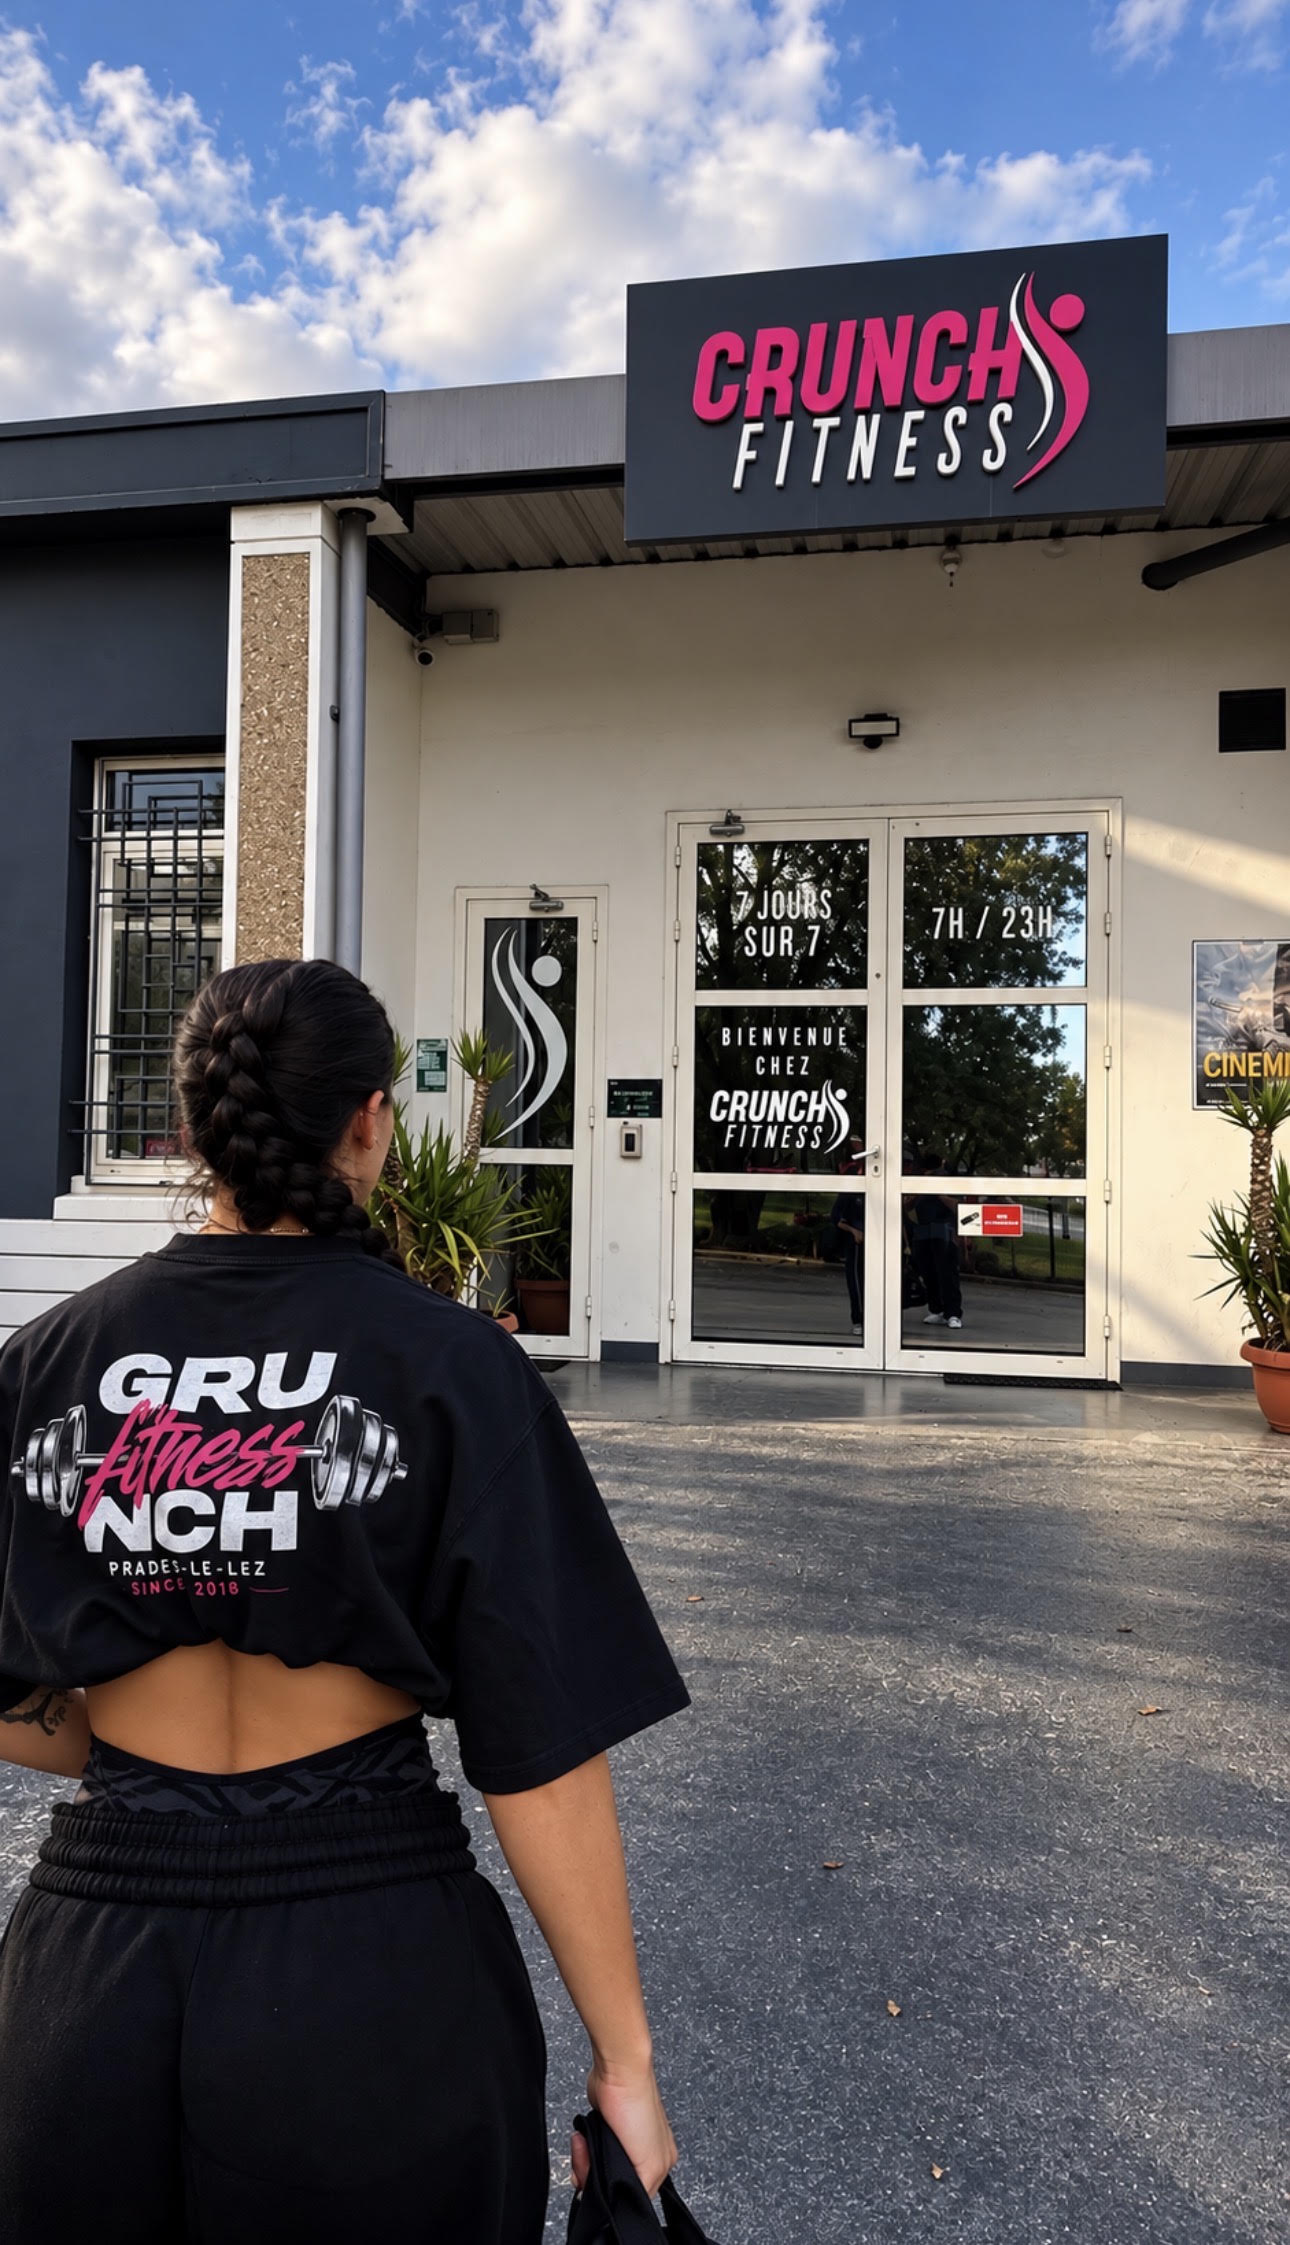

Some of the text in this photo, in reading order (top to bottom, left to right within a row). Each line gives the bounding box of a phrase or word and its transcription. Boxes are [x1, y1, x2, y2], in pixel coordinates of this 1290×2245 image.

[692, 306, 1024, 424] CRUNCH
[732, 401, 1013, 490] FITNESS
[736, 889, 832, 920] 7 JOURS
[932, 905, 1053, 939] 7H / 23H
[744, 925, 820, 957] SUR 7
[722, 1027, 847, 1046] BIENVENUE
[756, 1056, 810, 1076] CHEZ
[709, 1089, 828, 1123] CRUNCH
[724, 1124, 823, 1149] FITNESS
[99, 1351, 338, 1415] GRU
[84, 1489, 298, 1554] NCH
[109, 1559, 266, 1577] PRADES-LE-LEZ
[131, 1577, 186, 1596] SINCE
